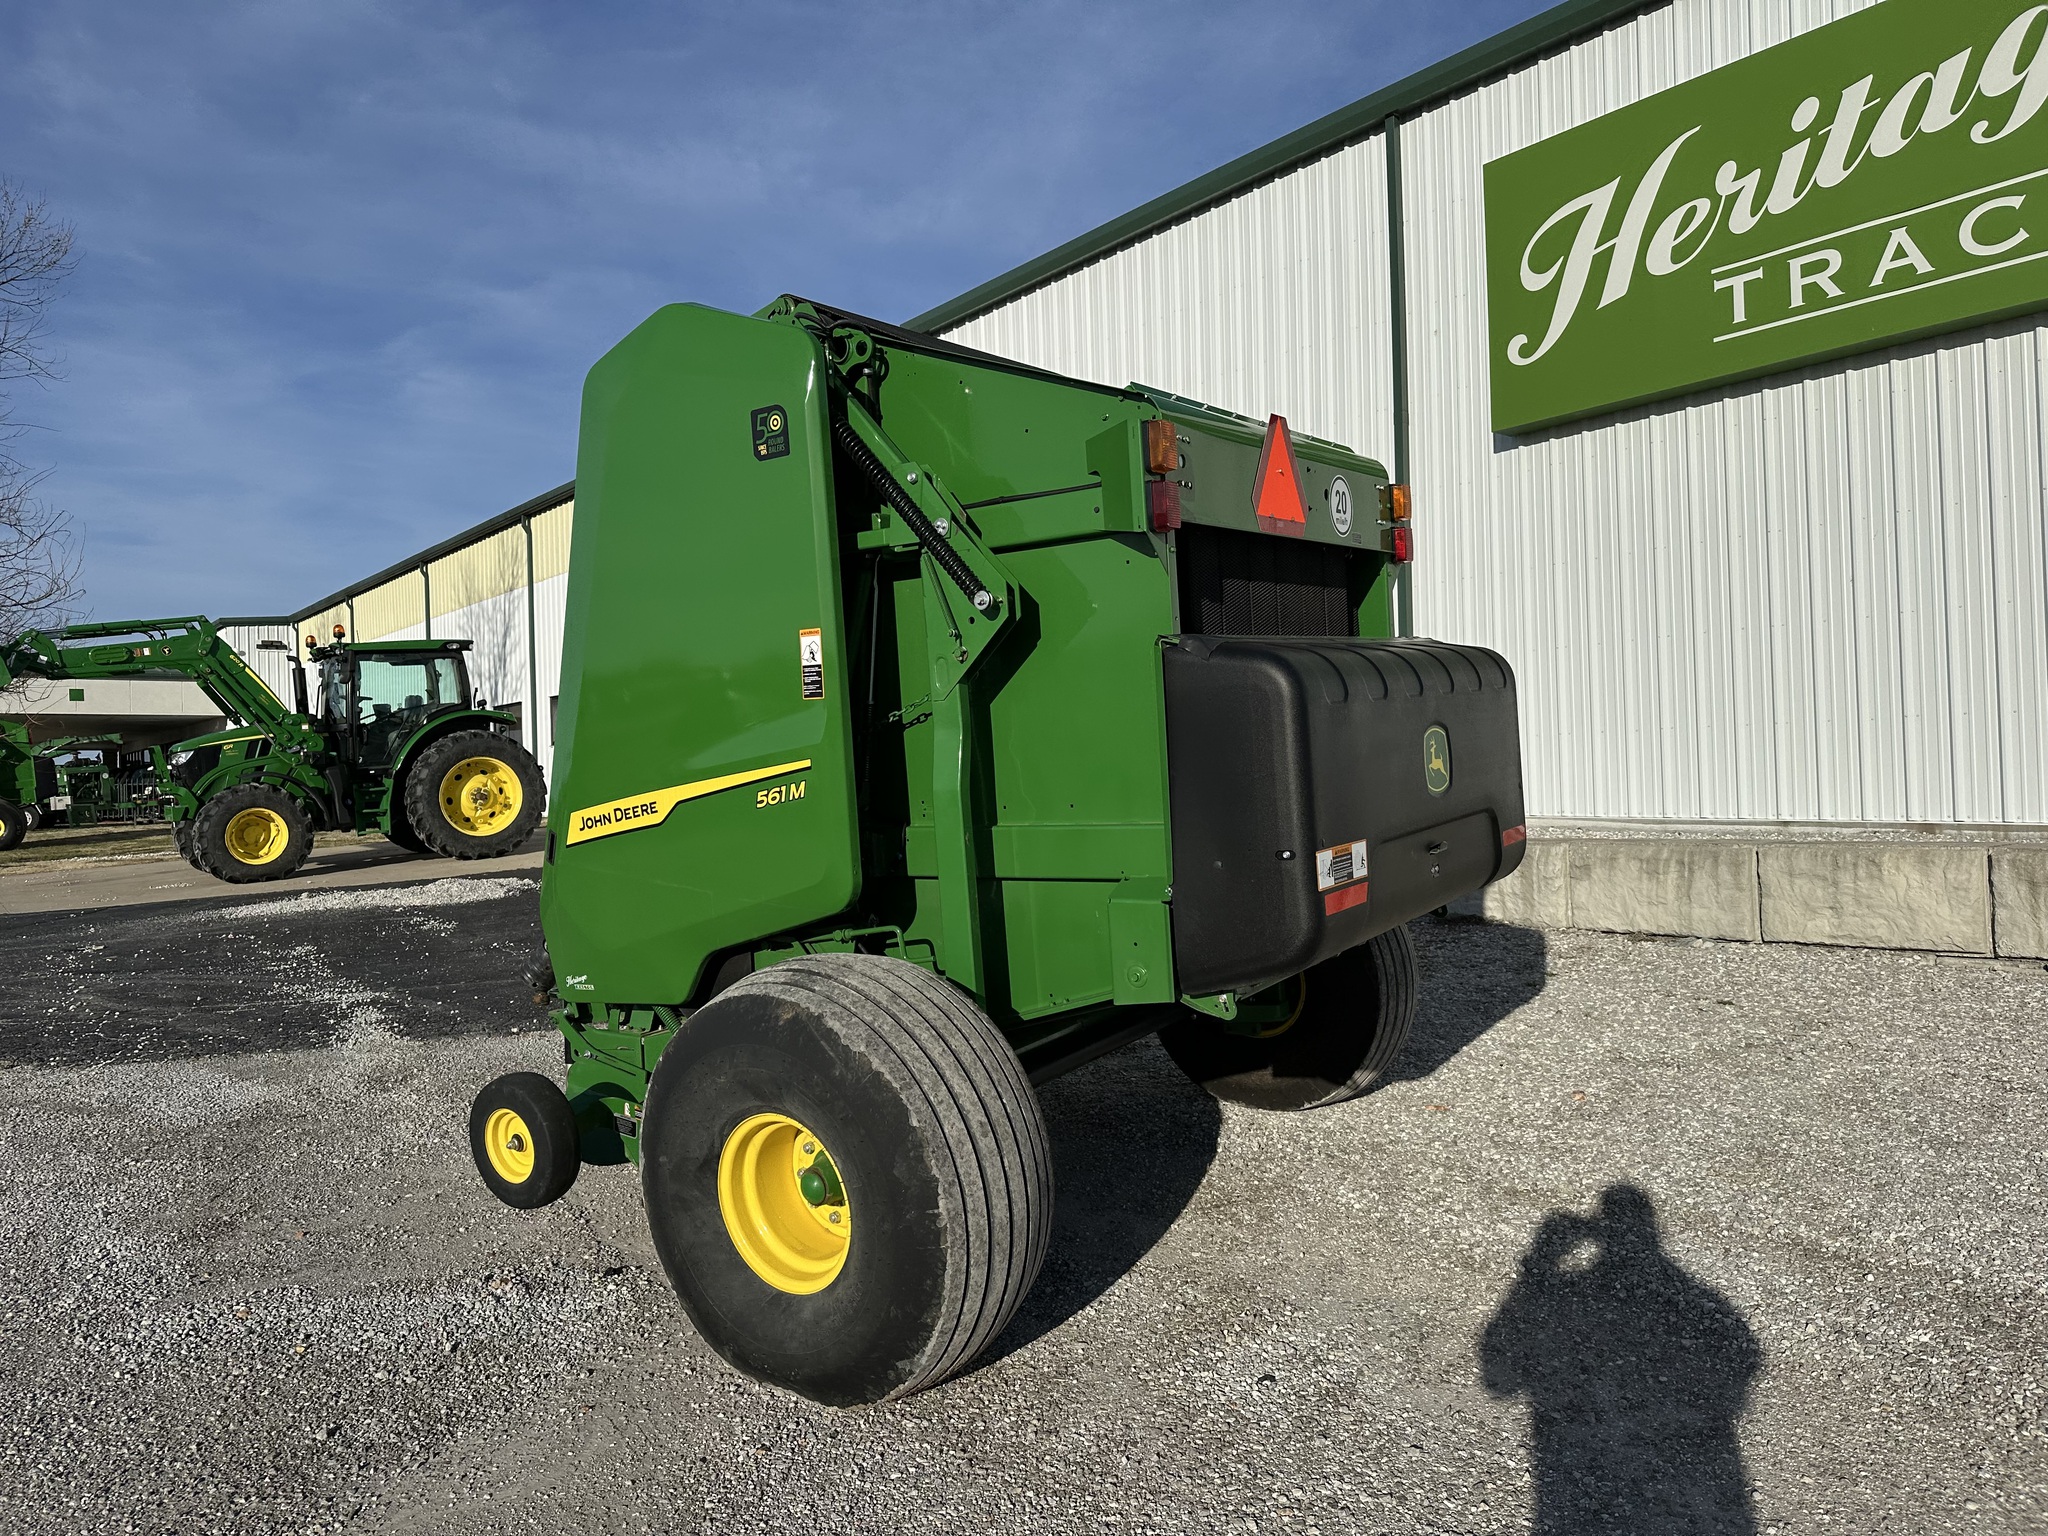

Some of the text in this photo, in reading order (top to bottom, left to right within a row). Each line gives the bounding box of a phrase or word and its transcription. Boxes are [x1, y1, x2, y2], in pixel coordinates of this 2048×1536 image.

[1713, 194, 2030, 324] TRAC
[1335, 489, 1347, 514] 20
[756, 780, 806, 809] 561 M
